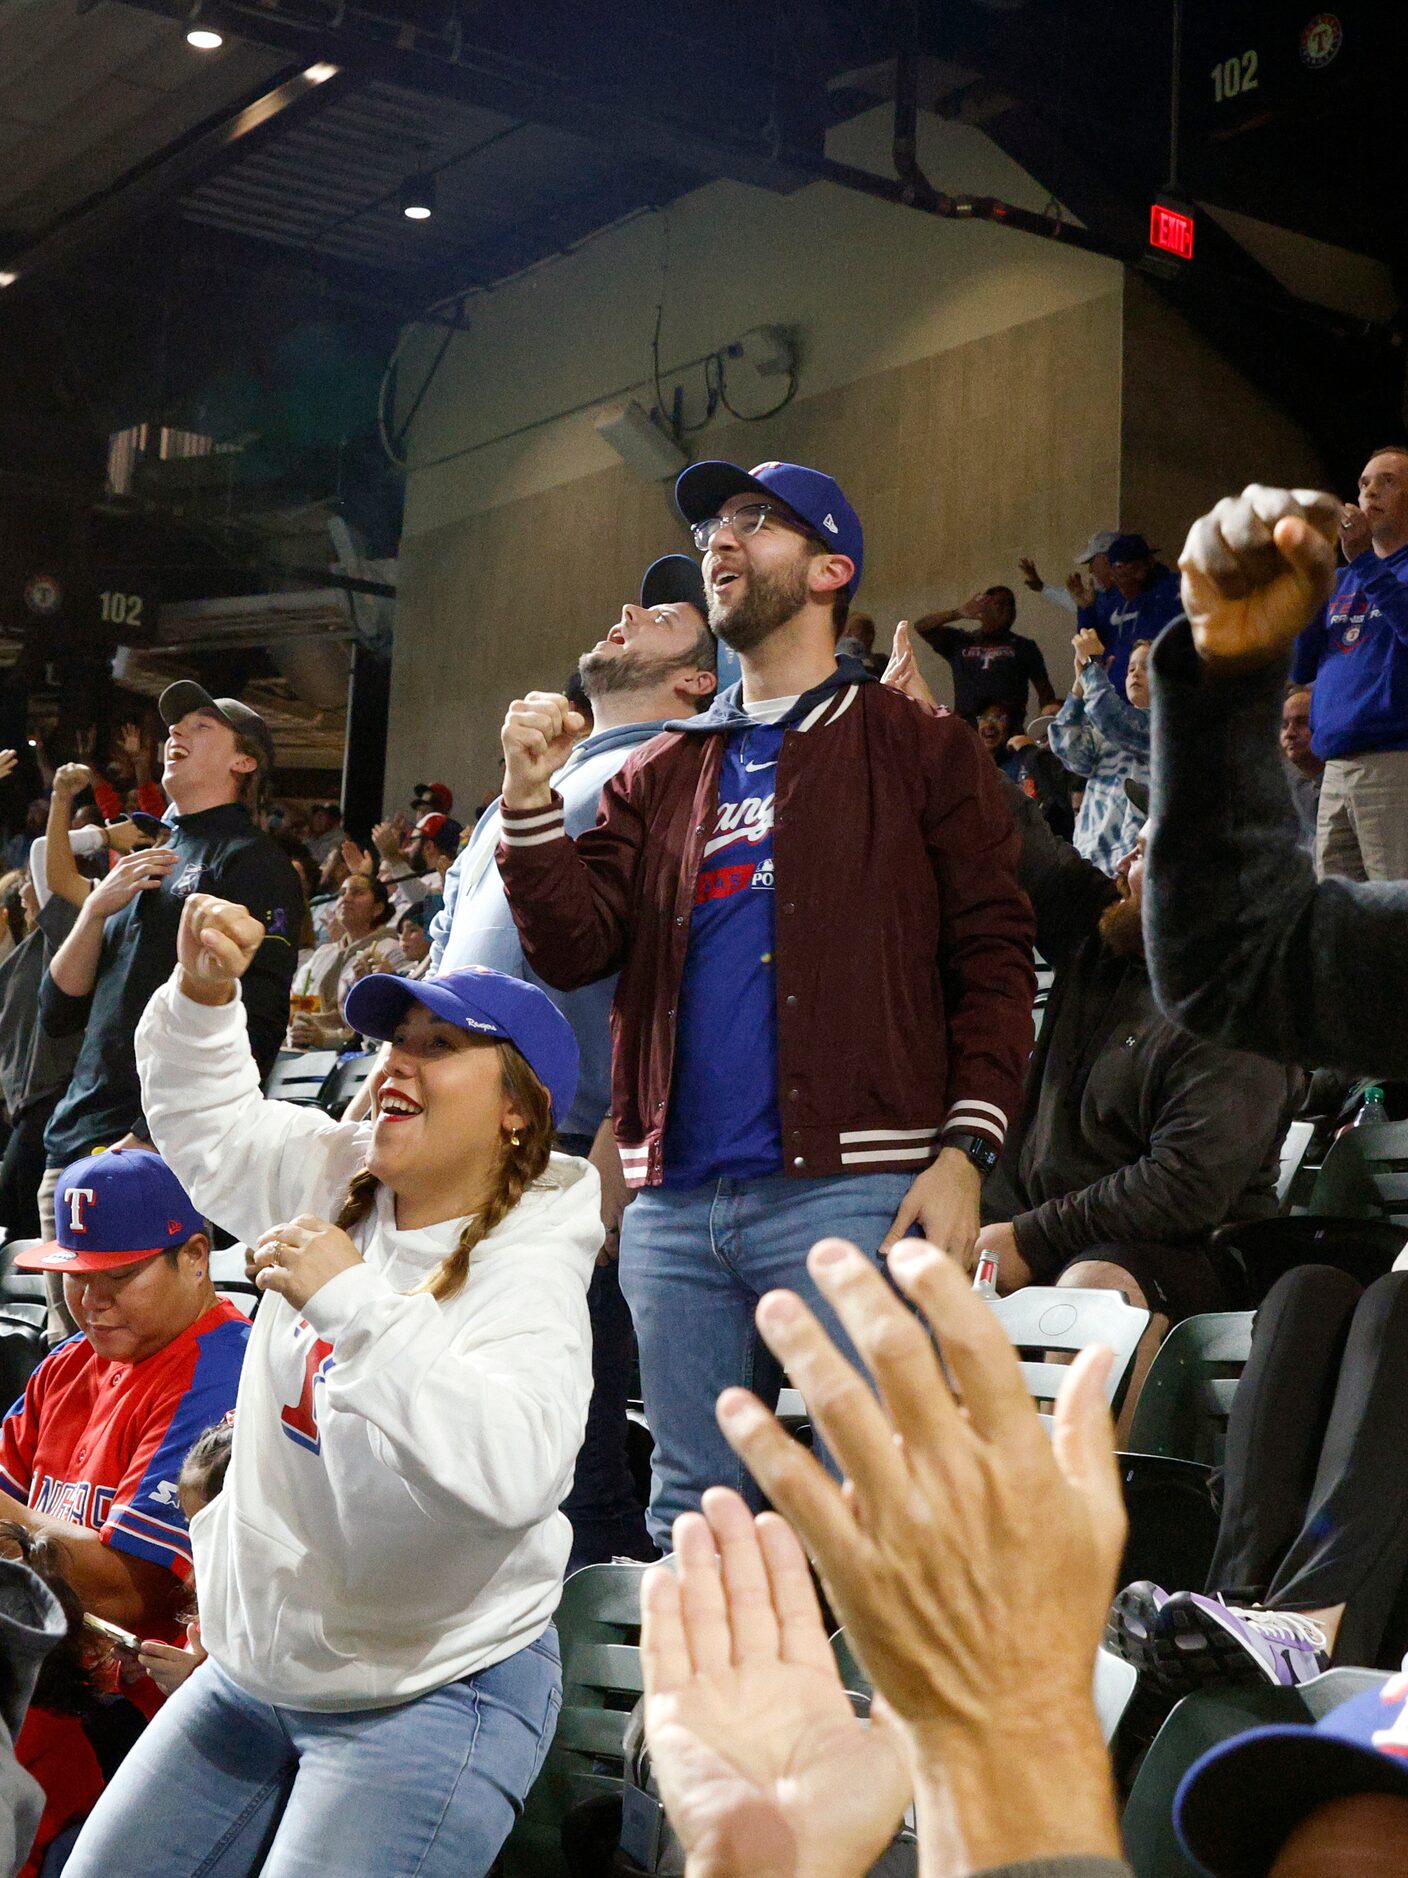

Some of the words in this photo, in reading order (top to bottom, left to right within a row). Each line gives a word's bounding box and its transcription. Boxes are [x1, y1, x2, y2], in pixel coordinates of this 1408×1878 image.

[1210, 50, 1258, 102] 102
[1160, 212, 1187, 252] EXIT
[100, 591, 143, 626] 102
[64, 1187, 97, 1233] T
